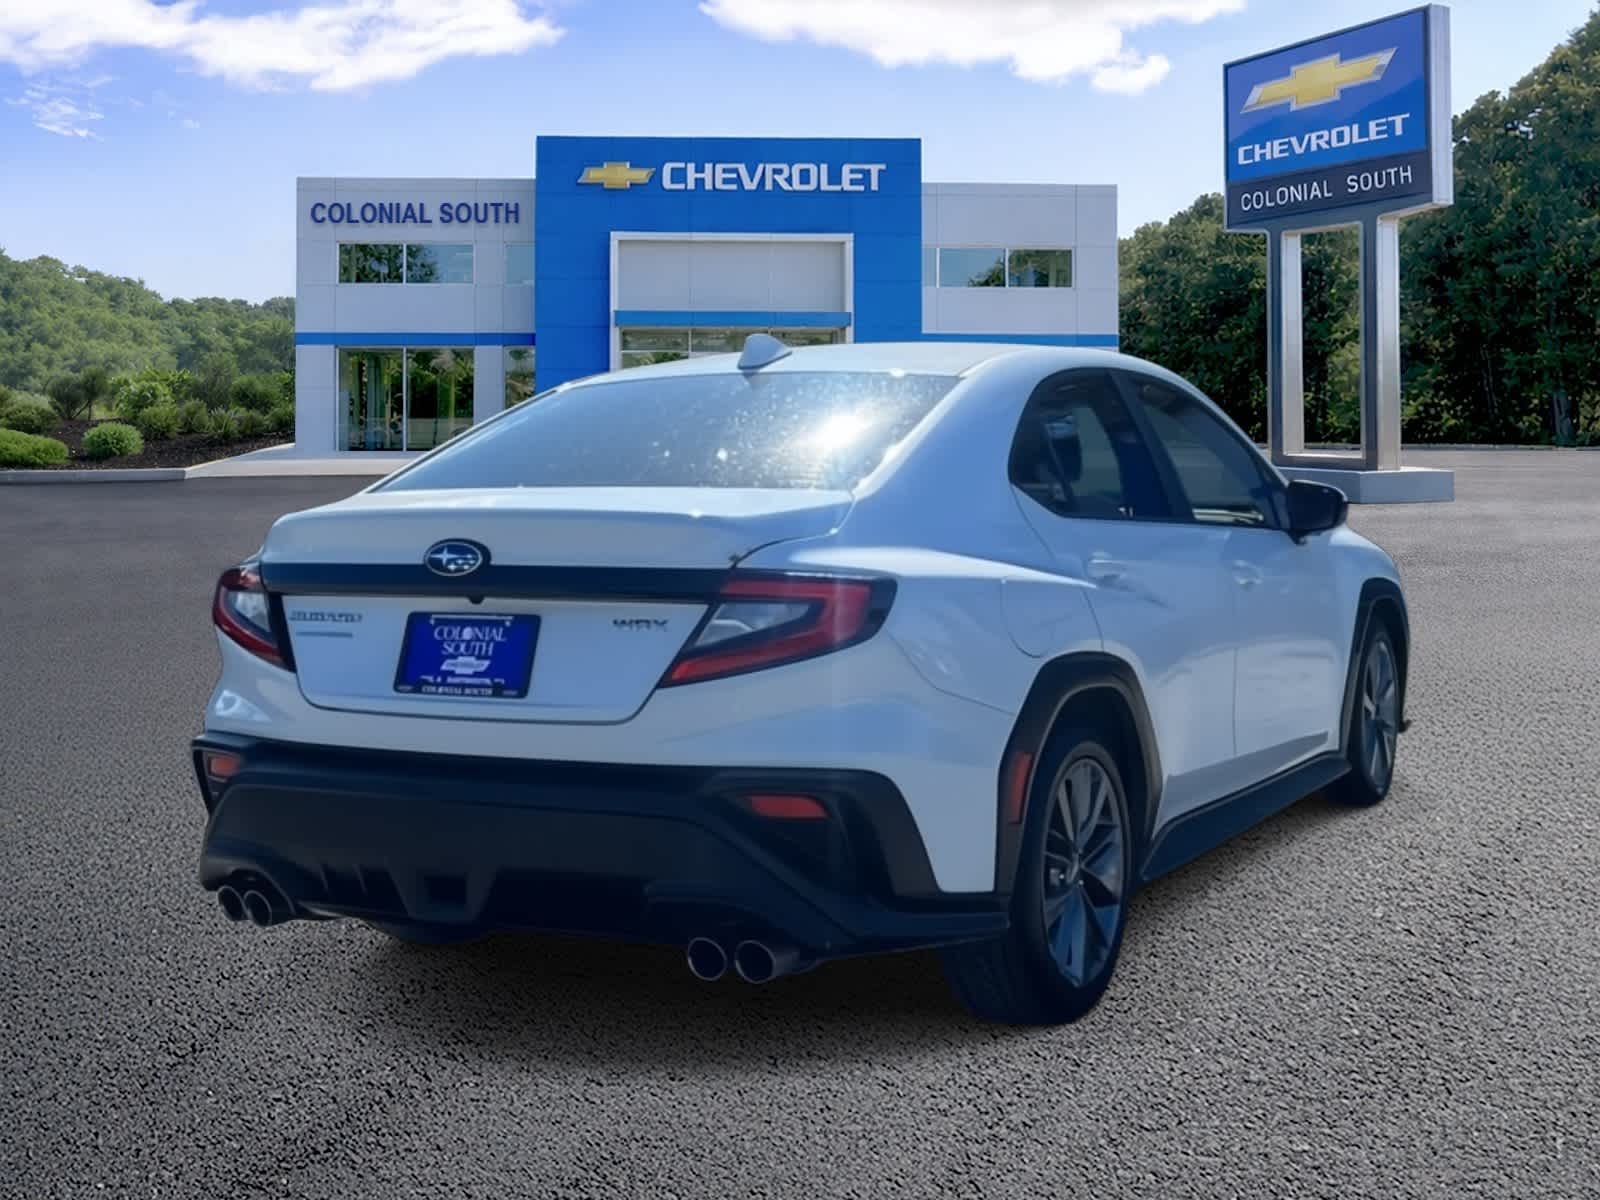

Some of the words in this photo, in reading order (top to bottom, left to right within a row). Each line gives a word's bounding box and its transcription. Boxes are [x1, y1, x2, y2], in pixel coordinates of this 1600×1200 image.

[1238, 113, 1410, 165] CHEVROLET
[662, 162, 887, 191] CHEVROLET
[1241, 180, 1333, 211] COLONIAL
[1346, 165, 1412, 193] SOUTH
[310, 202, 432, 224] COLONIAL
[439, 202, 519, 224] SOUTH
[434, 625, 507, 641] COLONIAL
[441, 640, 494, 656] SOUTH
